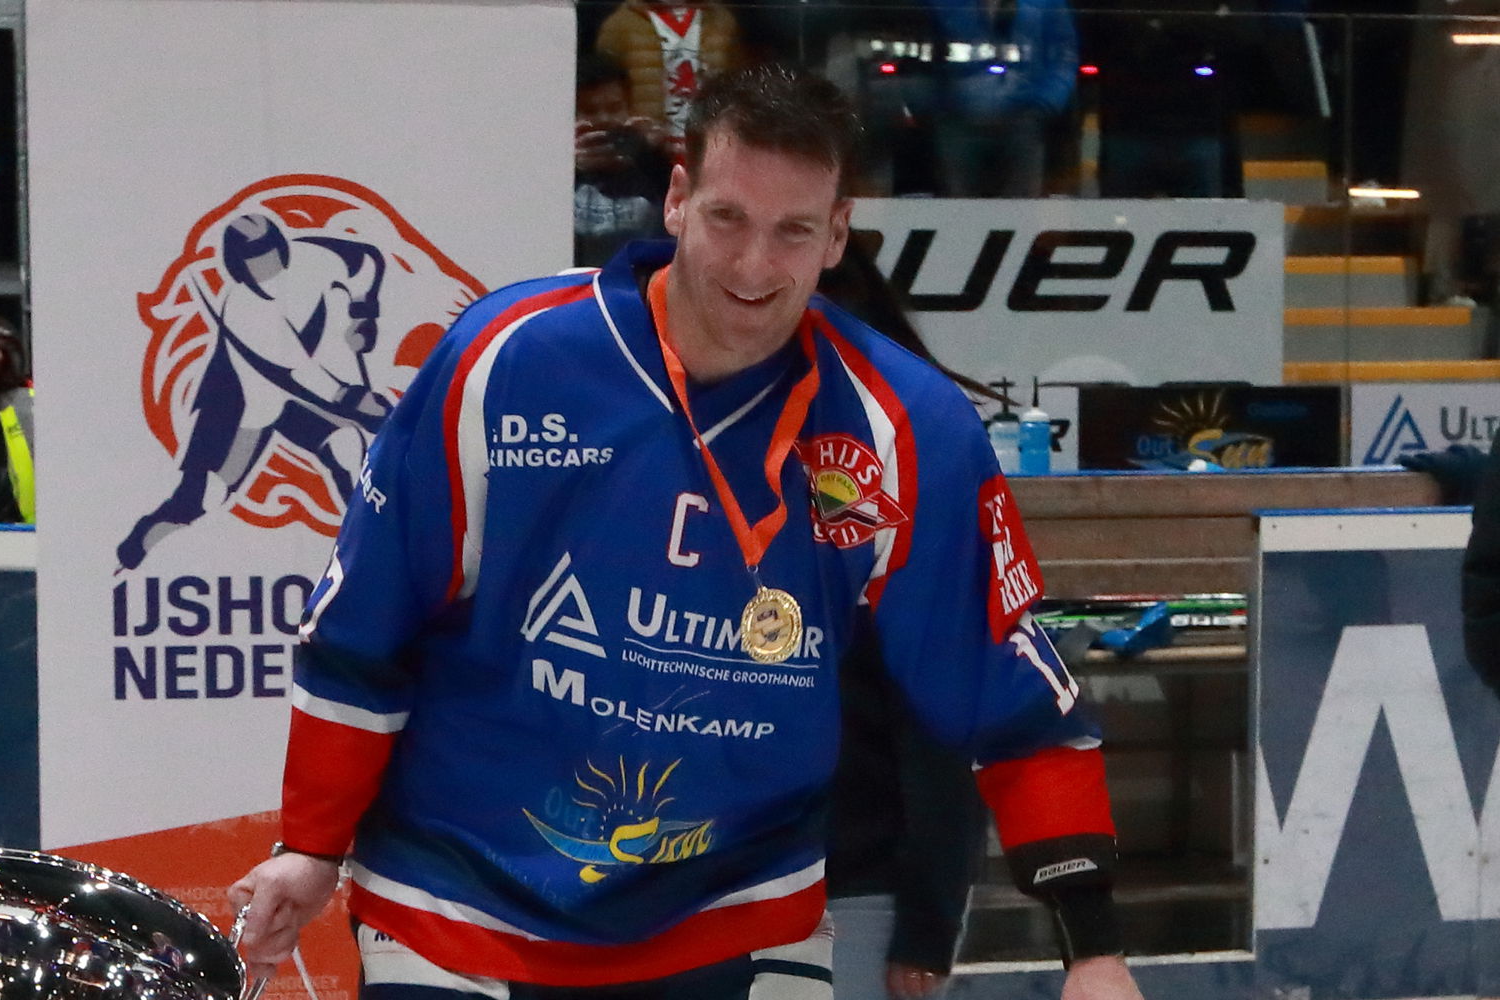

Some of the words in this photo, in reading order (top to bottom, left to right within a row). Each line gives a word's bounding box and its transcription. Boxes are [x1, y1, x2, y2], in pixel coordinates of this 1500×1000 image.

[667, 492, 709, 567] C
[626, 586, 826, 660] ULTIMR
[114, 644, 300, 700] NEDE
[531, 658, 776, 740] MOLENKAMP
[732, 671, 816, 688] GROOTHANDEL
